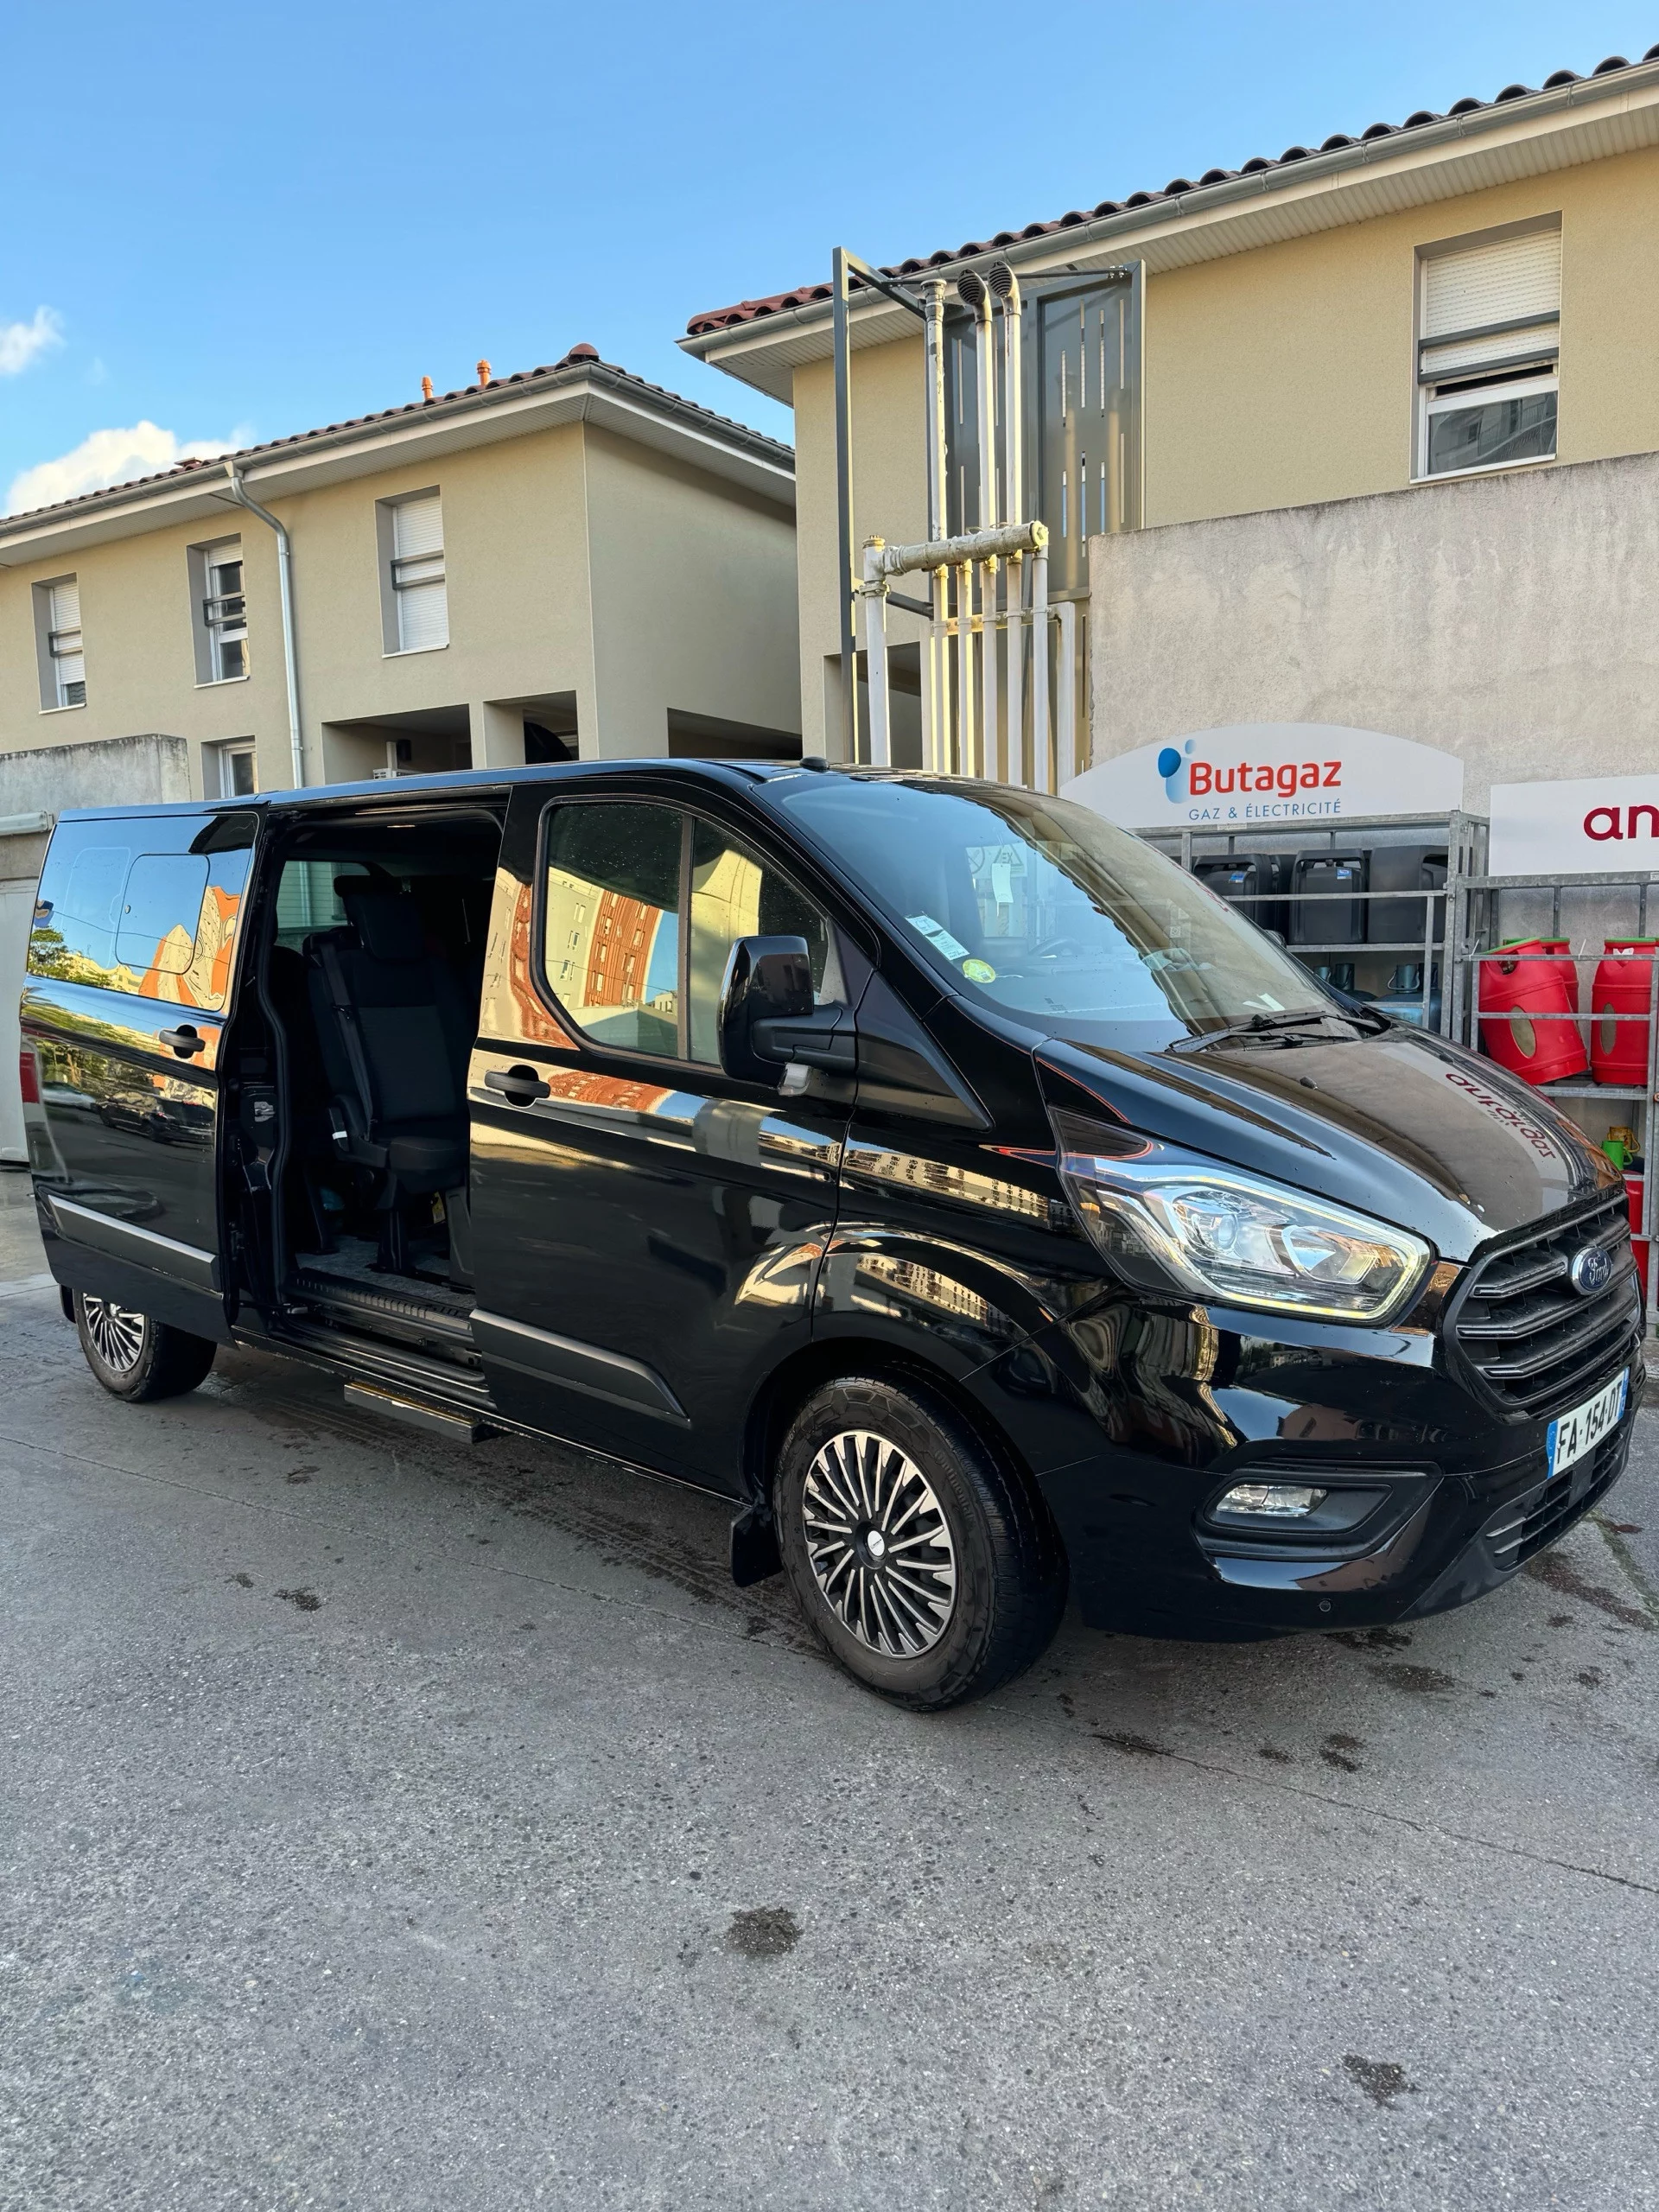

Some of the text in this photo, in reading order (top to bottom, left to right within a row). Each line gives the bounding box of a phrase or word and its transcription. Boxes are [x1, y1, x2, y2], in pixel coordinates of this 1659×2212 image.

[1190, 761, 1342, 798] Butagaz
[1189, 798, 1341, 821] GAZ & ÉLECTRICITÉ
